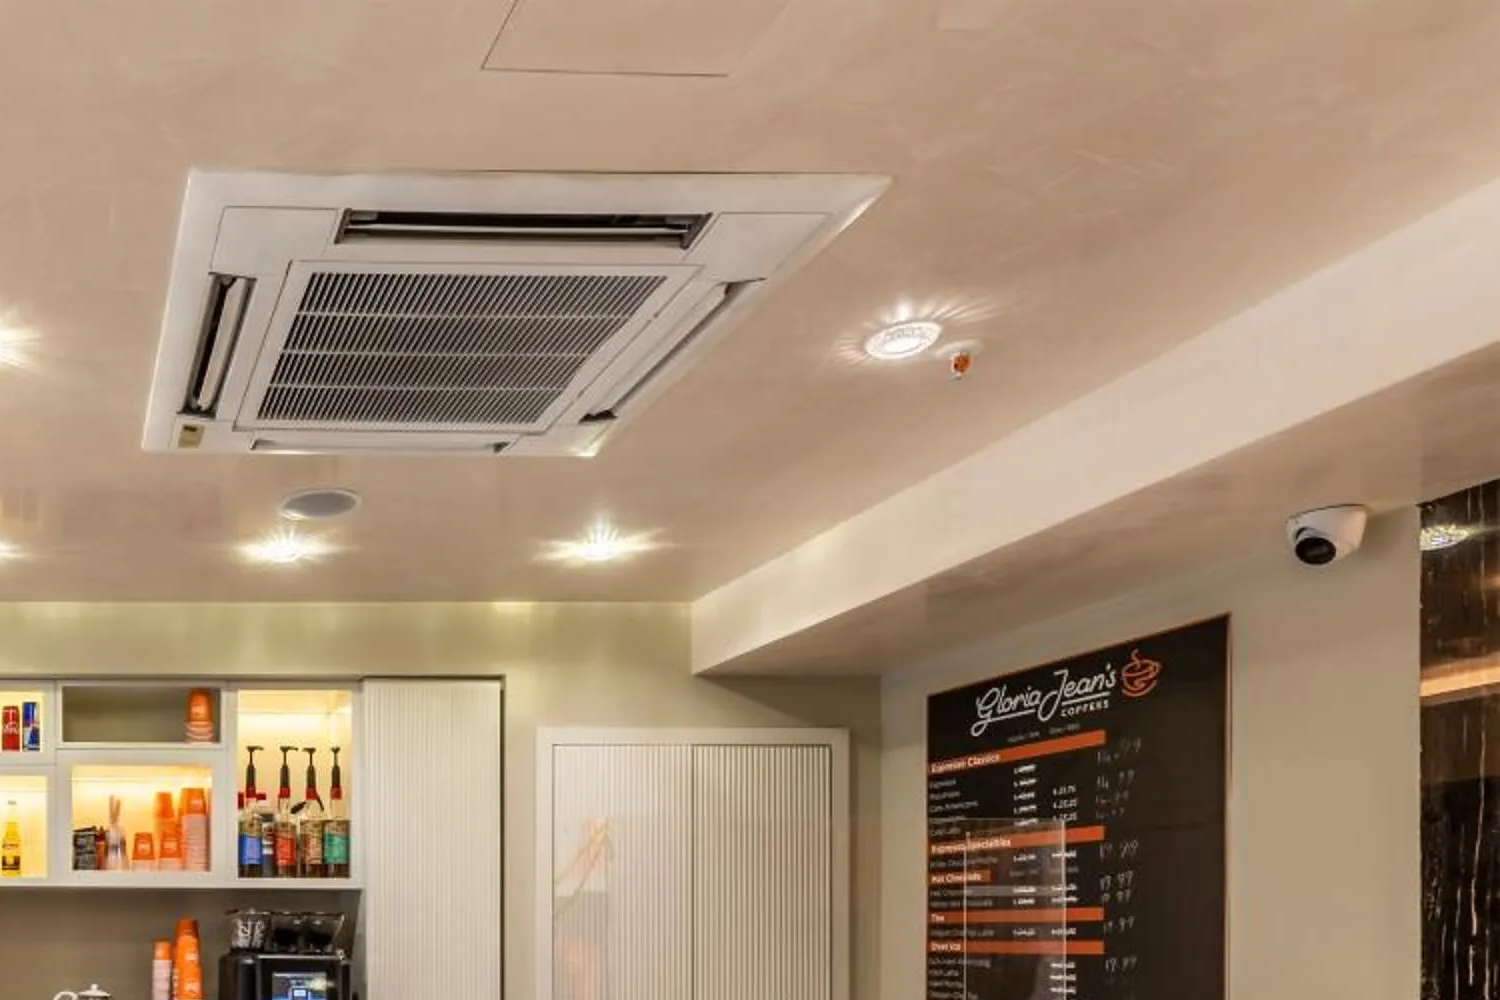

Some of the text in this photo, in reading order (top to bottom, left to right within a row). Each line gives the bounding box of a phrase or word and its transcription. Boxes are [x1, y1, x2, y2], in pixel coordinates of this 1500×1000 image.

[970, 663, 1117, 737] Gloria Jean's
[1060, 700, 1110, 718] COFFEES
